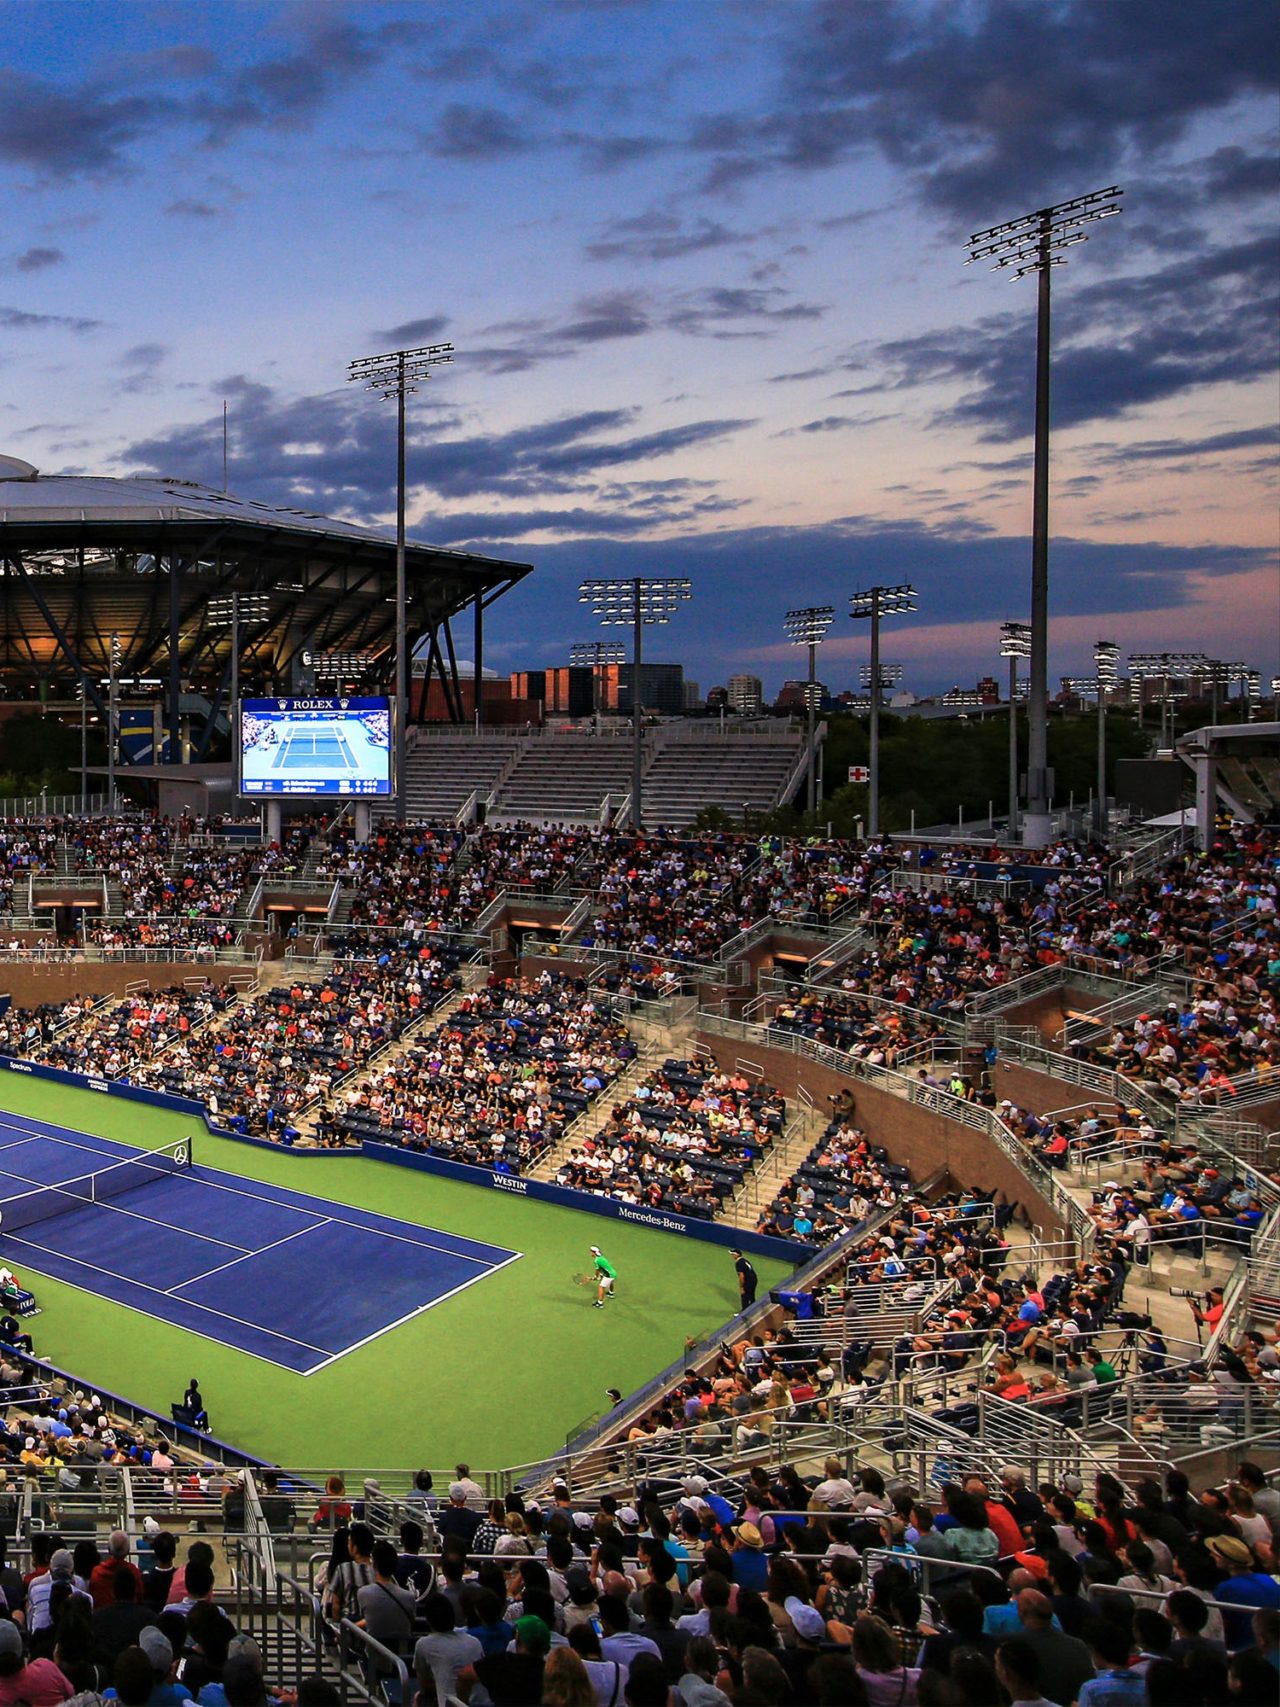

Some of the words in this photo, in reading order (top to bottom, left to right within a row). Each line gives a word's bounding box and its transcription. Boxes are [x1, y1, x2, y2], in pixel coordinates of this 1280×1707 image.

[293, 700, 334, 710] ROLEX
[492, 1173, 528, 1190] WESTIN
[618, 1206, 686, 1232] Mercedes-Benz
